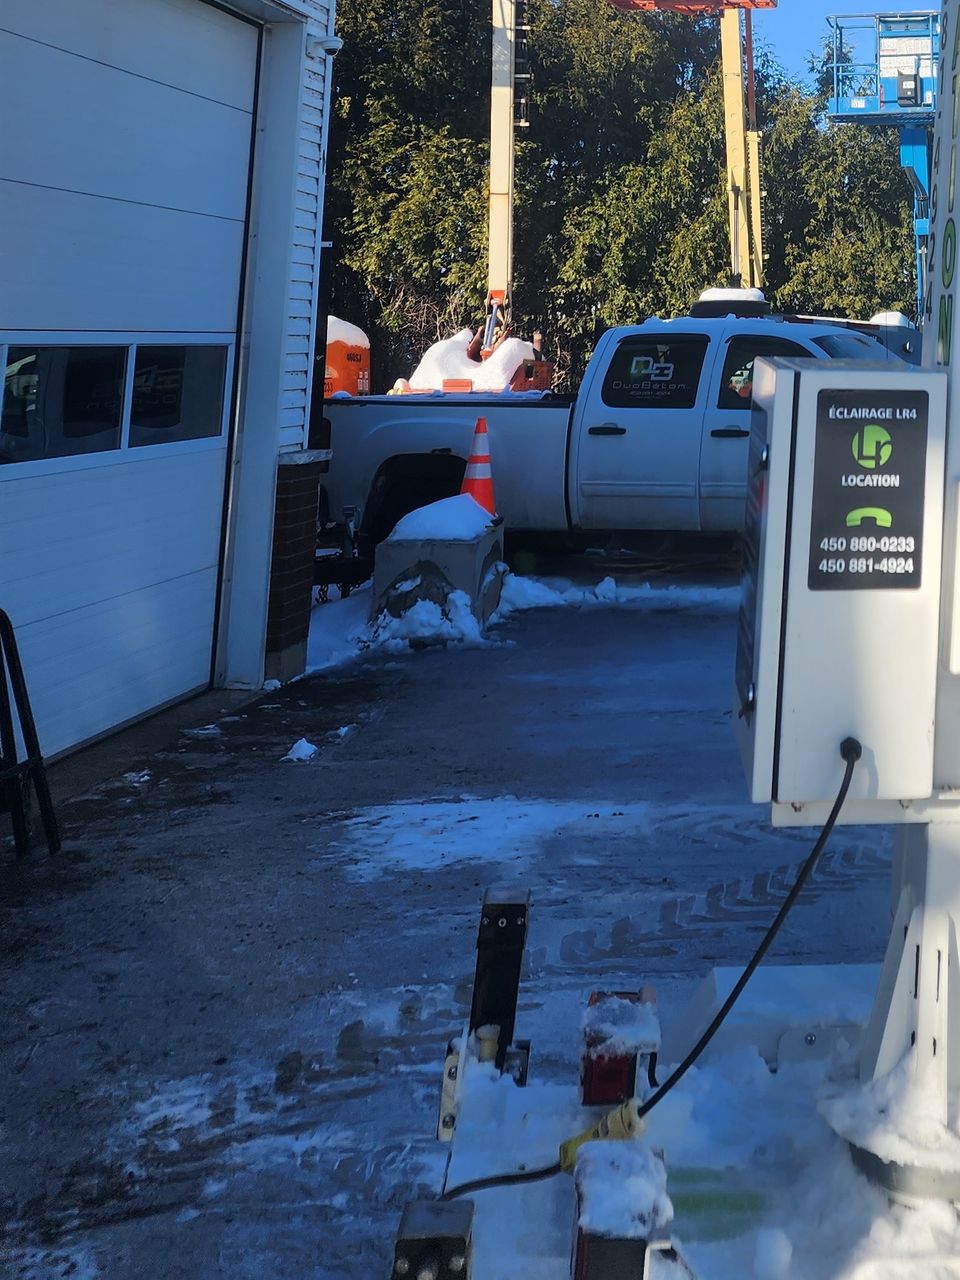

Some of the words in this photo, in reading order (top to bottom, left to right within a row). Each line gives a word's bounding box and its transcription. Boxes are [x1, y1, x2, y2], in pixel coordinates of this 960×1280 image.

[828, 404, 893, 420] ÉCLAIRAGE
[896, 407, 917, 419] LR4
[841, 474, 900, 488] LOCATION
[820, 537, 847, 552] 450
[850, 536, 915, 553] 880-0233
[818, 558, 846, 573] 450
[848, 557, 914, 574] 881-4924
